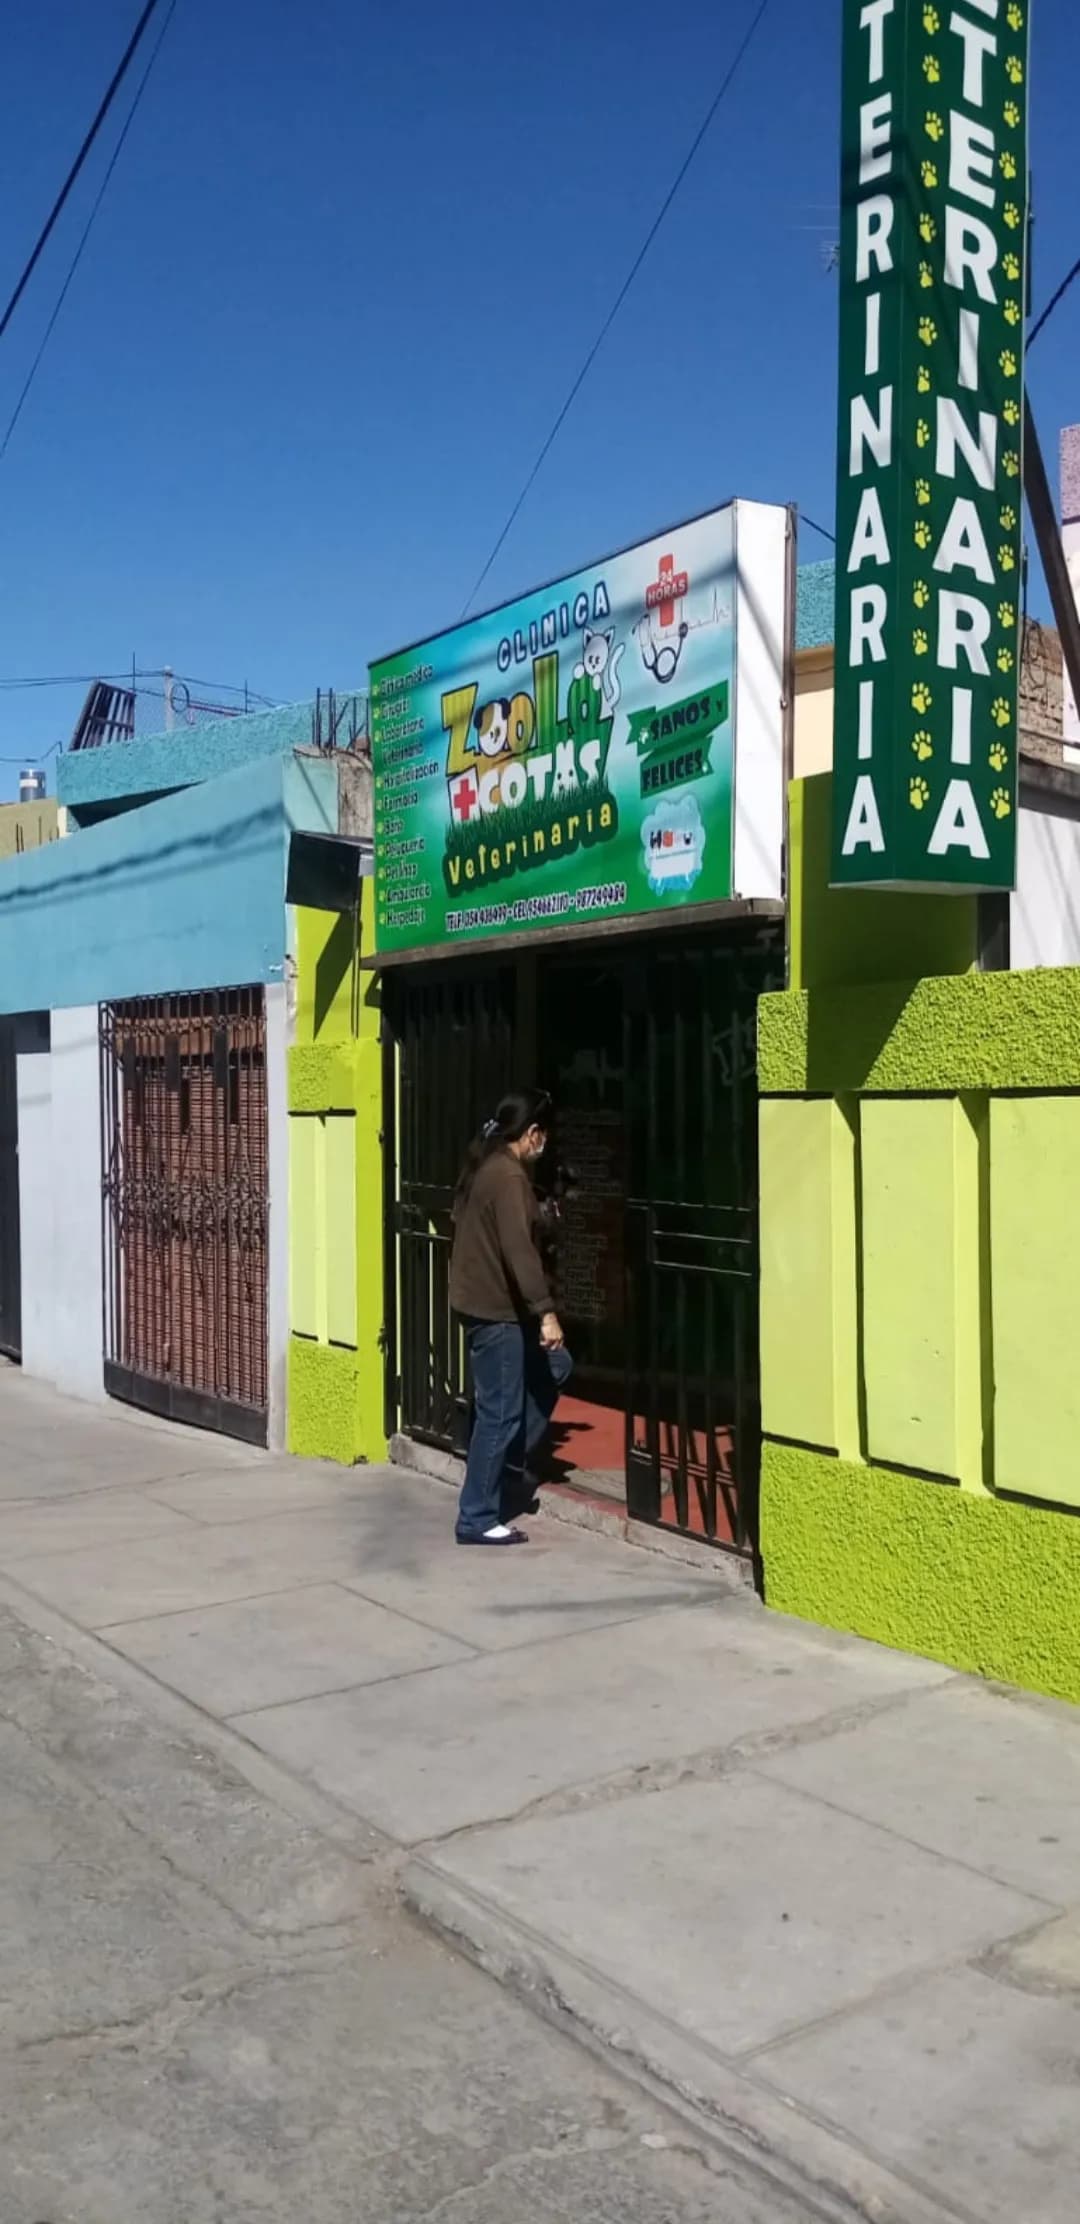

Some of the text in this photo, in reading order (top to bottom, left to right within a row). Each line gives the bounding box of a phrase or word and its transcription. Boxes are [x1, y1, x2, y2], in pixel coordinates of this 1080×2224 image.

[927, 0, 998, 860] TERINARIA
[647, 579, 687, 605] HORAS
[658, 568, 675, 587] 24
[497, 580, 611, 673] CLINICA
[650, 695, 711, 741] SANOS
[641, 748, 704, 791] FELICES
[448, 803, 612, 885] Veterinaria
